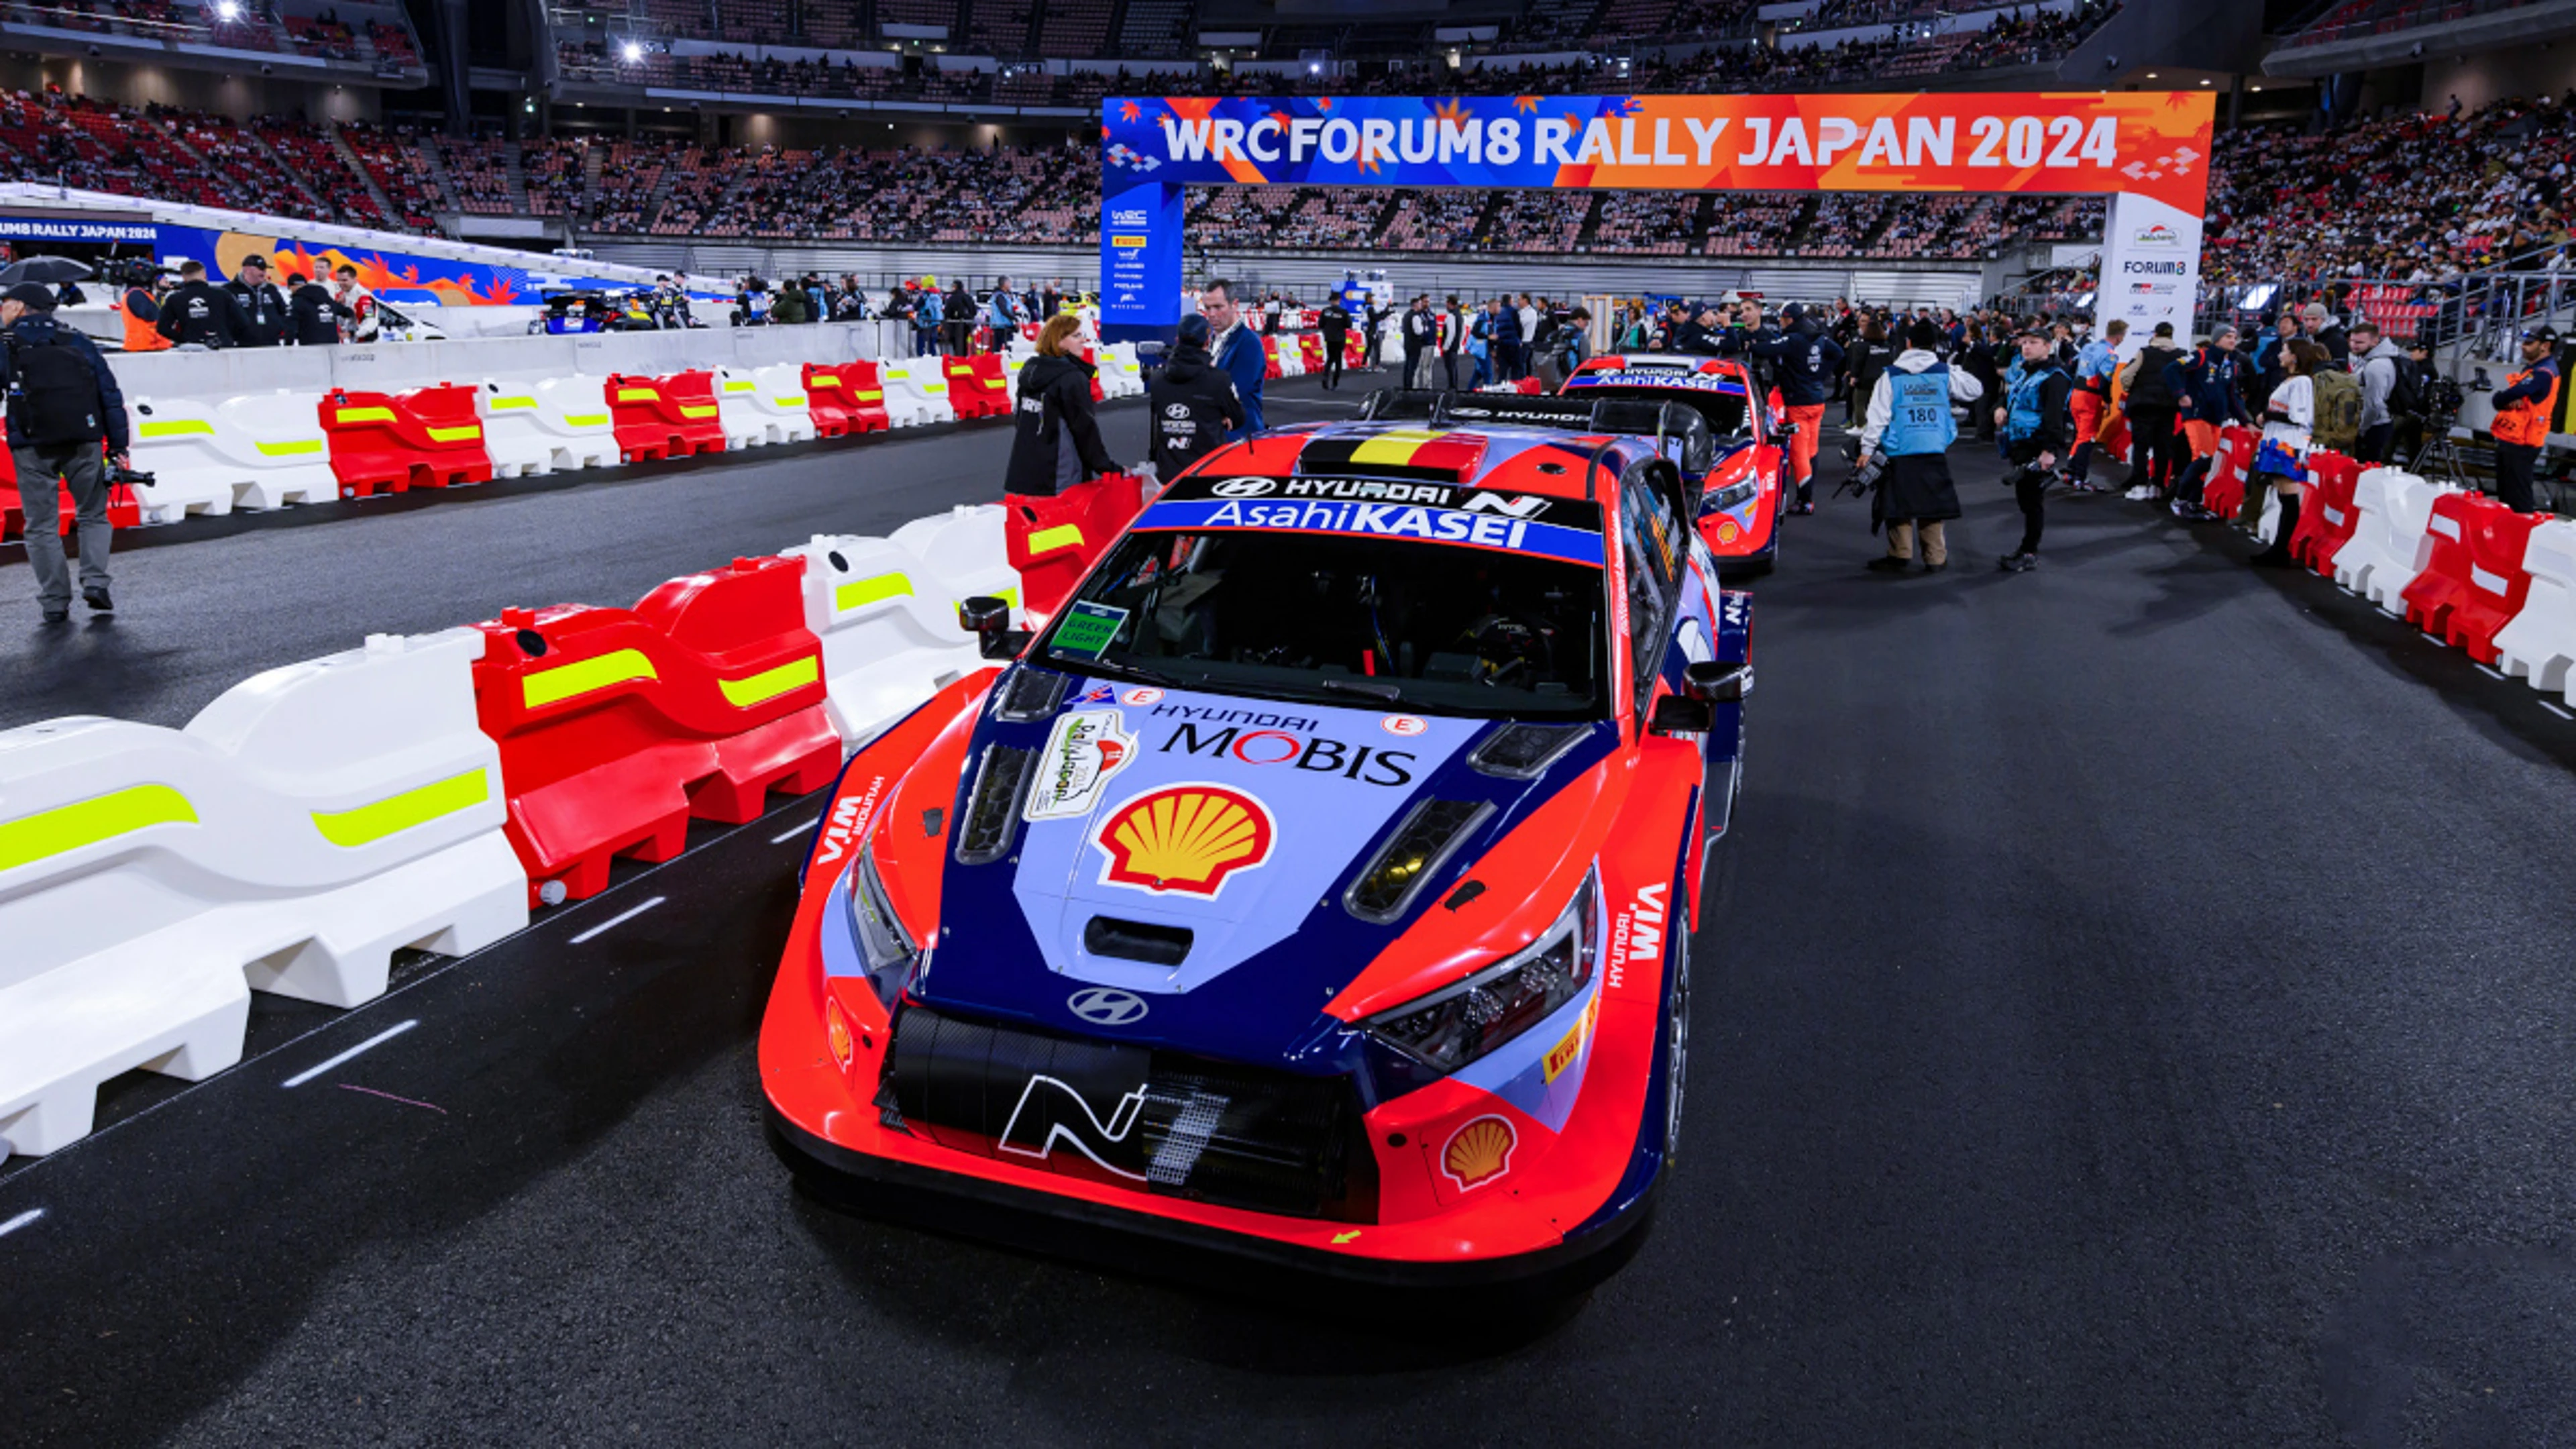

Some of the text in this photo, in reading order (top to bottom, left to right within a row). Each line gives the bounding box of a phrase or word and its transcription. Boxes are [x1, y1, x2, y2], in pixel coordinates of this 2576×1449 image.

[1164, 116, 2118, 168] WRC FORUM8 RALLY JAPAN 2024
[32, 223, 78, 237] RALLY
[80, 225, 125, 238] JAPAN
[127, 227, 157, 239] 2024
[2124, 262, 2186, 276] FORUM8
[1625, 369, 1688, 377] HYUNDAI
[1497, 410, 1591, 421] HYUNDA
[1908, 407, 1937, 423] 180
[1284, 479, 1451, 504] HYUNDAI
[1067, 616, 1115, 633] GREEN
[1062, 631, 1104, 645] LIGHT
[1131, 691, 1155, 702] E
[1150, 704, 1319, 732] HYUNDAI
[1395, 718, 1414, 731] E
[1159, 722, 1417, 787] MOBIS
[852, 775, 885, 835] HYUNDAI
[817, 796, 863, 865] WIA
[1629, 882, 1666, 960] WIA
[1608, 912, 1630, 987] HYUNDAI
